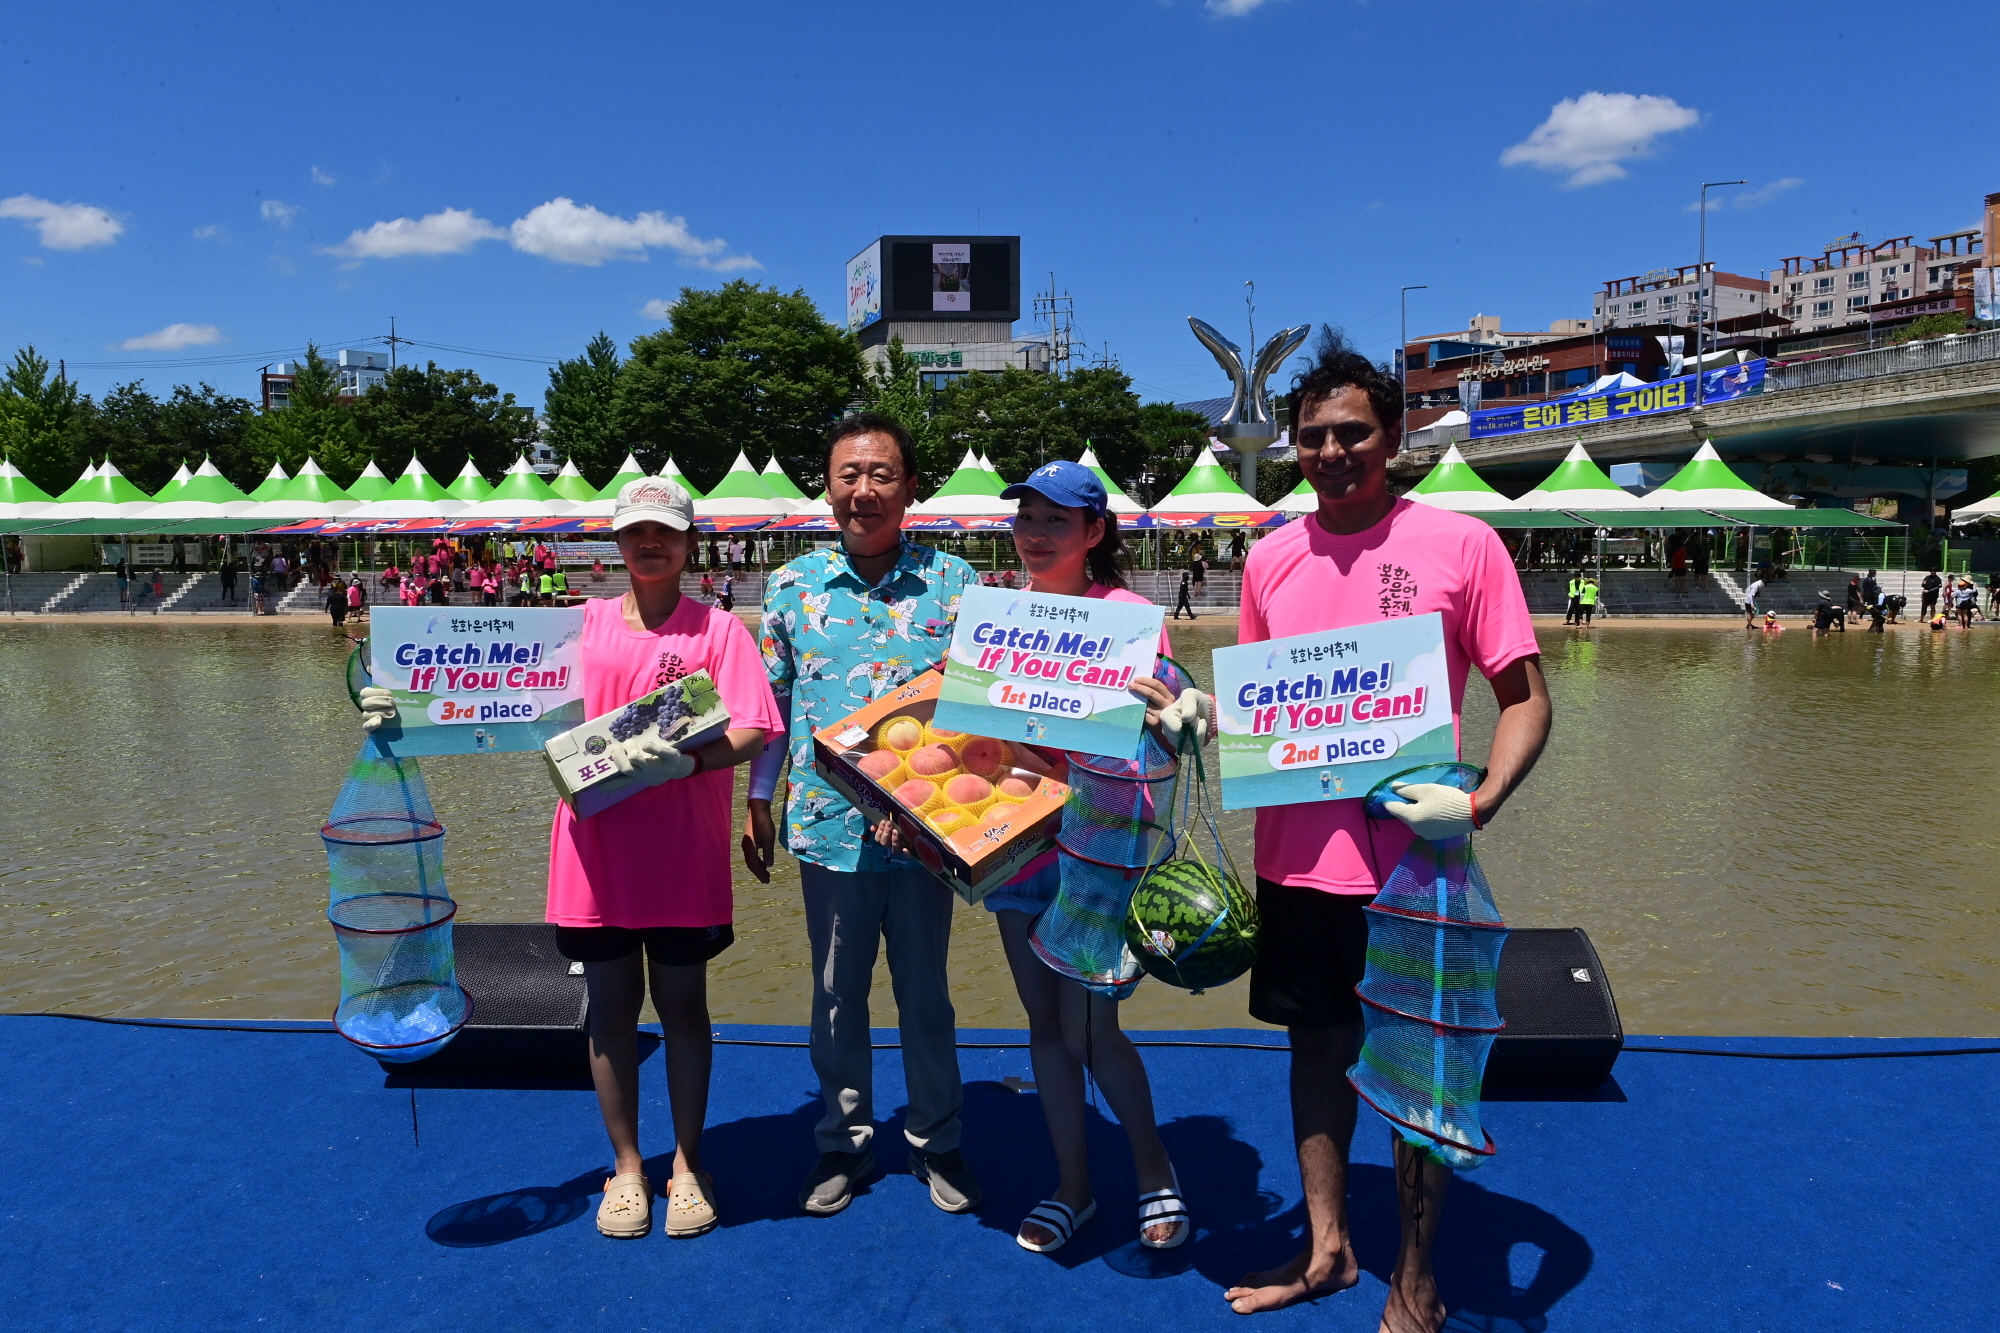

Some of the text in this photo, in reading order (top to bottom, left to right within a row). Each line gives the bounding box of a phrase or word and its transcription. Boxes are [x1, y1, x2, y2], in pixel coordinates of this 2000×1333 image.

[1462, 355, 1543, 381] 동산종합의원
[1523, 381, 1686, 429] 은어 숯불 구이터
[629, 483, 673, 499] Studios
[1379, 563, 1410, 585] 봉화
[1389, 583, 1418, 599] 은어
[1029, 603, 1090, 623] 봉화은어축제
[1379, 597, 1413, 617] 축제
[450, 618, 514, 633] 봉화은어축제
[973, 623, 1112, 659] Catch Me!
[1290, 641, 1358, 664] 봉화은어축제
[396, 642, 541, 666] Catch Me!
[658, 652, 683, 668] 봉화
[409, 666, 569, 692] If You Can!
[977, 647, 1133, 689] If You Can!
[689, 675, 704, 685] 2kg
[1237, 662, 1391, 708] Catch Me!
[440, 700, 533, 721] 3rd place
[1000, 685, 1082, 714] 1st place
[1252, 686, 1425, 735] If You Can!
[1281, 738, 1385, 765] 2nd place
[983, 821, 1012, 844] 복숭아
